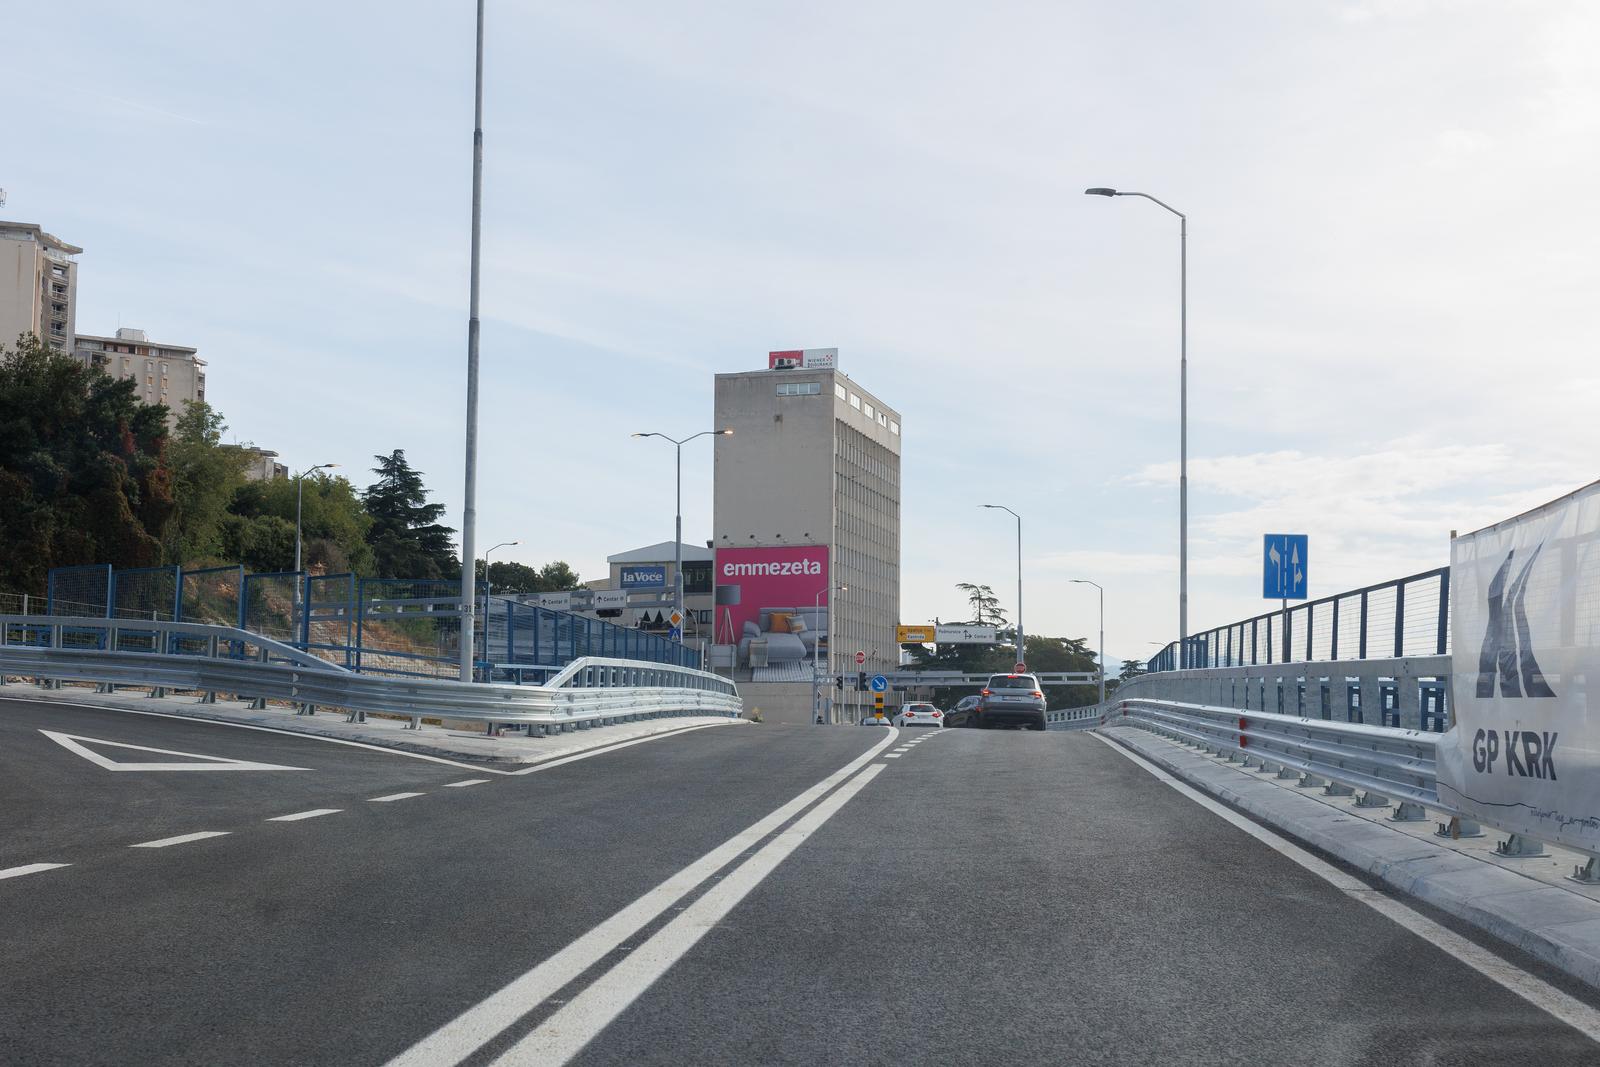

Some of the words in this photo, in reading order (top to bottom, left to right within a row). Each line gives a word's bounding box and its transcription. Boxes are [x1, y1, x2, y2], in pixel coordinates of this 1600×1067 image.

[723, 558, 821, 576] emmezeta
[1473, 728, 1499, 774] GP
[1504, 731, 1559, 781] KRK
